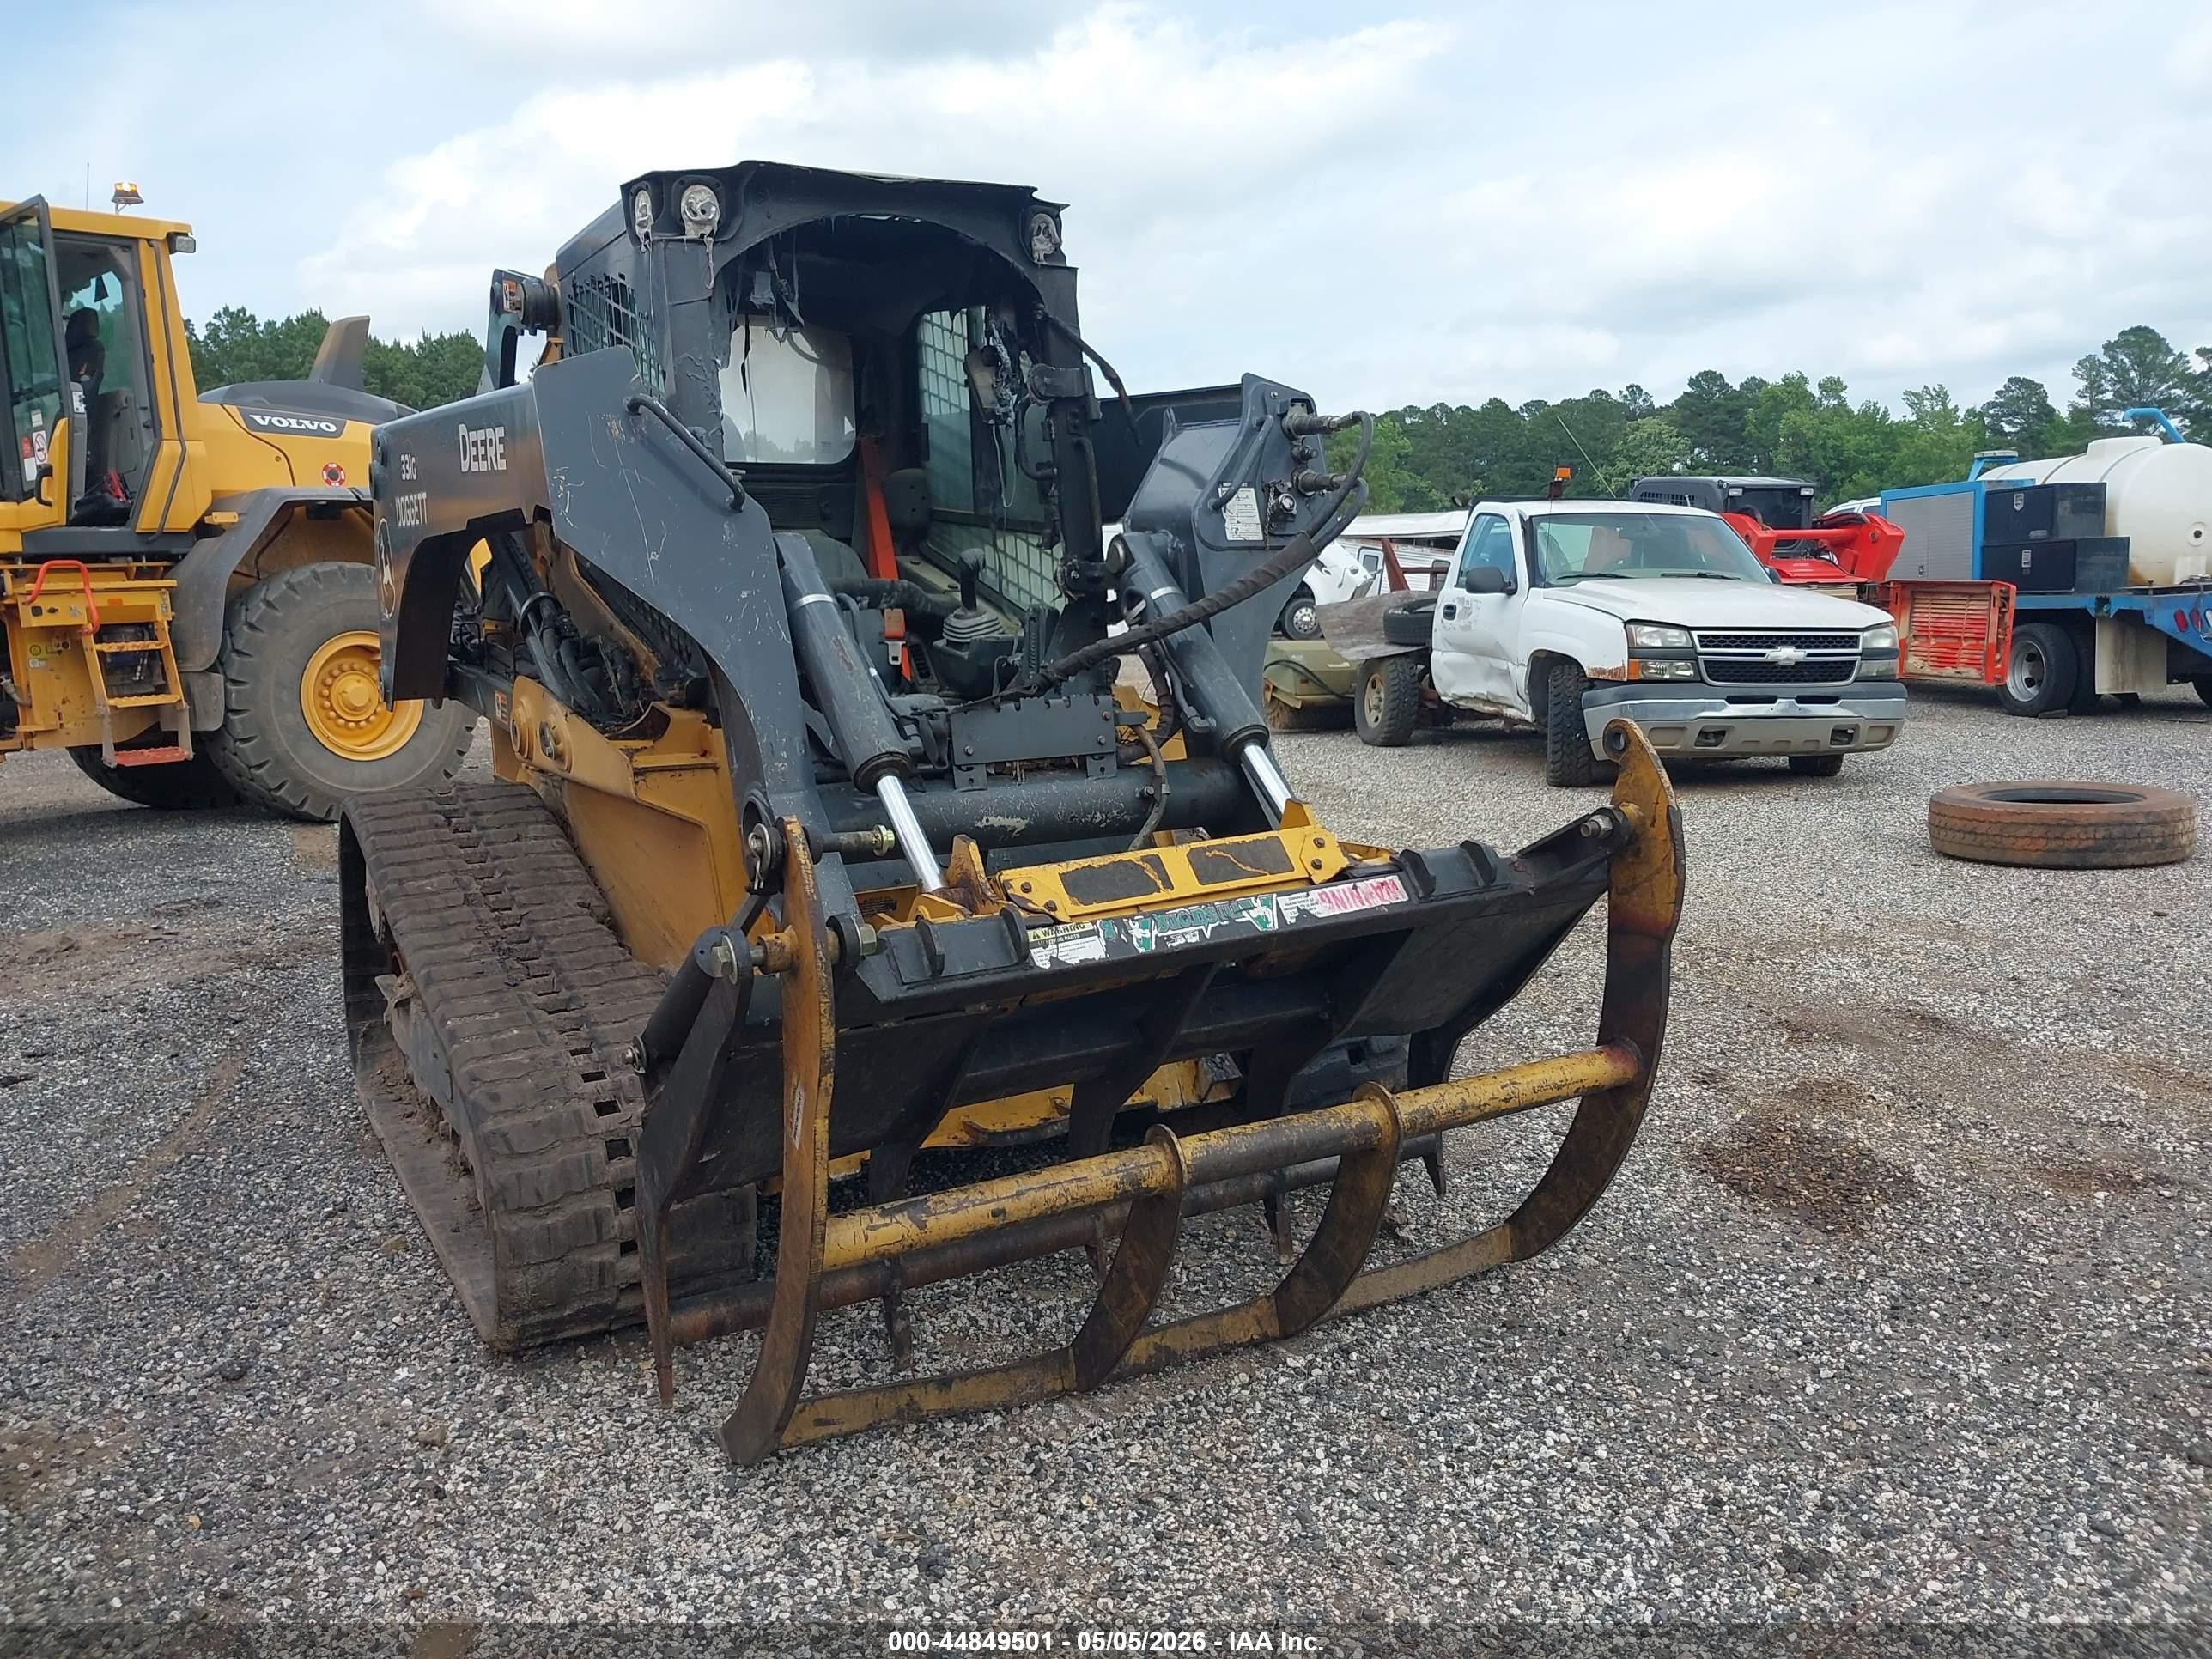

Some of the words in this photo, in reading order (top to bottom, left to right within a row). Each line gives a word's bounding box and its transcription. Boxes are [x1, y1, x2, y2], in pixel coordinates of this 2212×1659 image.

[249, 414, 337, 432] VOLVO
[400, 453, 416, 480] 331G
[396, 492, 428, 526] DOGGETT
